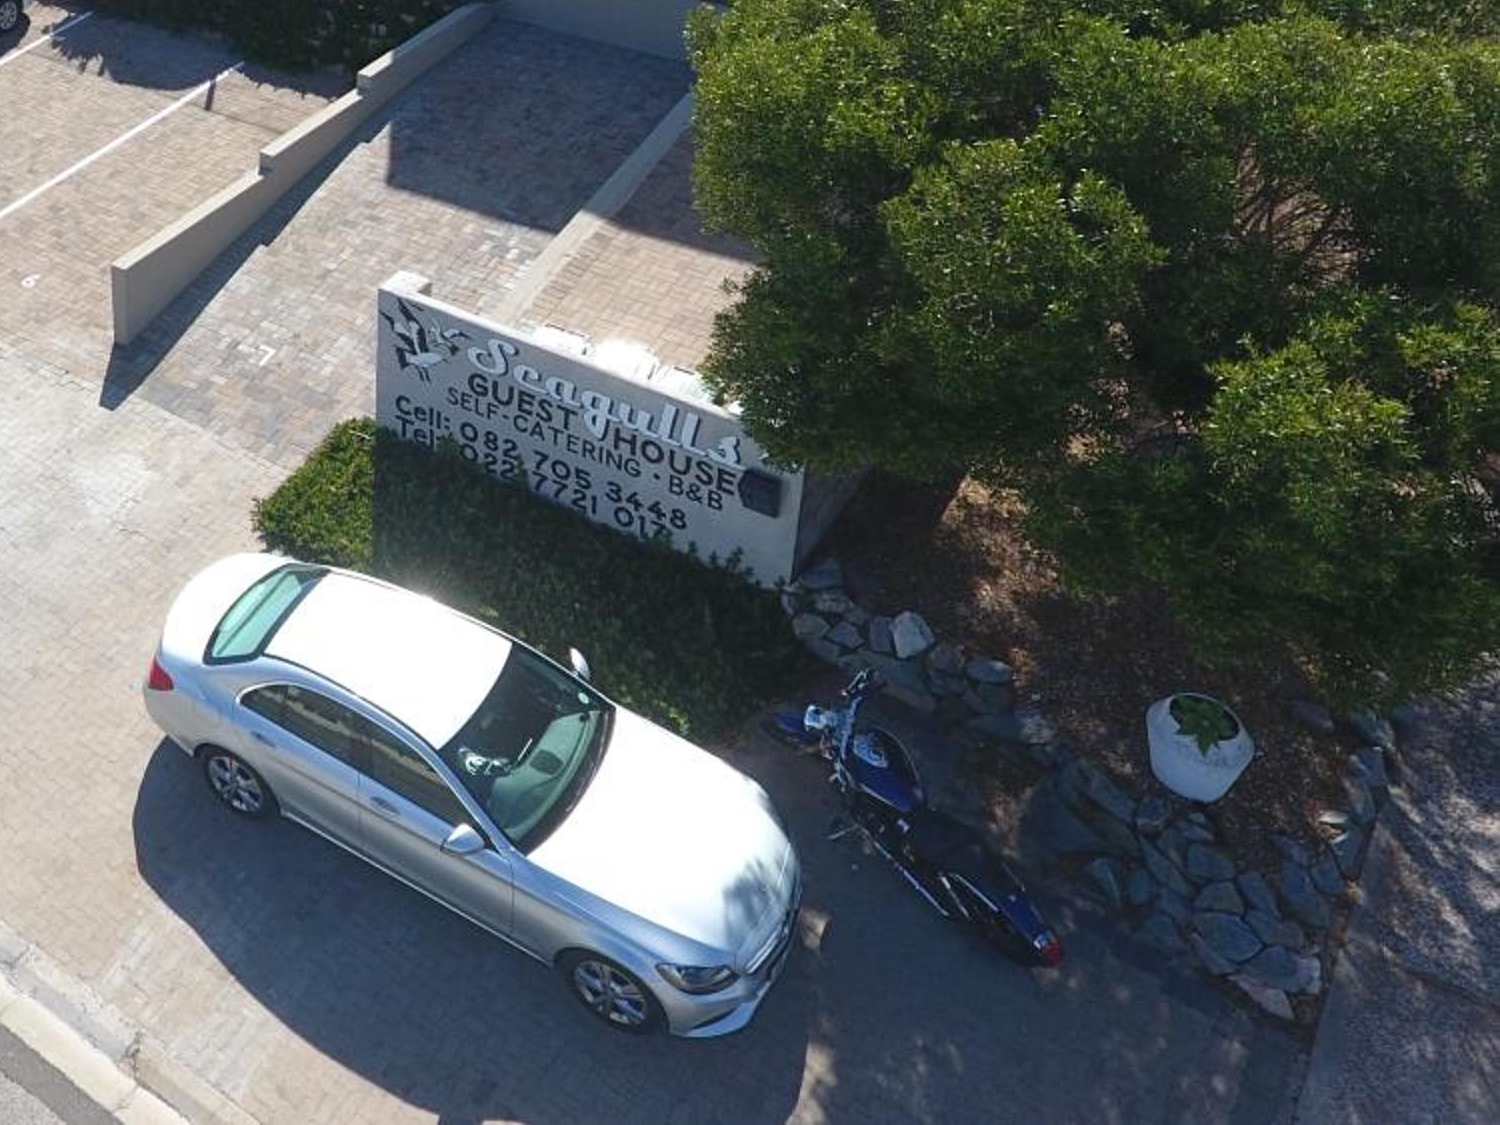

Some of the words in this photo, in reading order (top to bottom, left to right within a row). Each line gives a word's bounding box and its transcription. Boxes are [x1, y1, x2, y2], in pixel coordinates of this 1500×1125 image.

[395, 395, 450, 430] Cell:
[460, 422, 518, 461] 082
[533, 449, 591, 490] 705
[605, 481, 687, 529] 3448
[447, 386, 642, 478] SELF-CATERING
[668, 475, 723, 510] B&B
[468, 338, 746, 470] Seagulls
[468, 373, 578, 430] GUEST
[613, 427, 737, 496] HOUSE
[460, 444, 516, 478] 022
[532, 471, 597, 514] 7721
